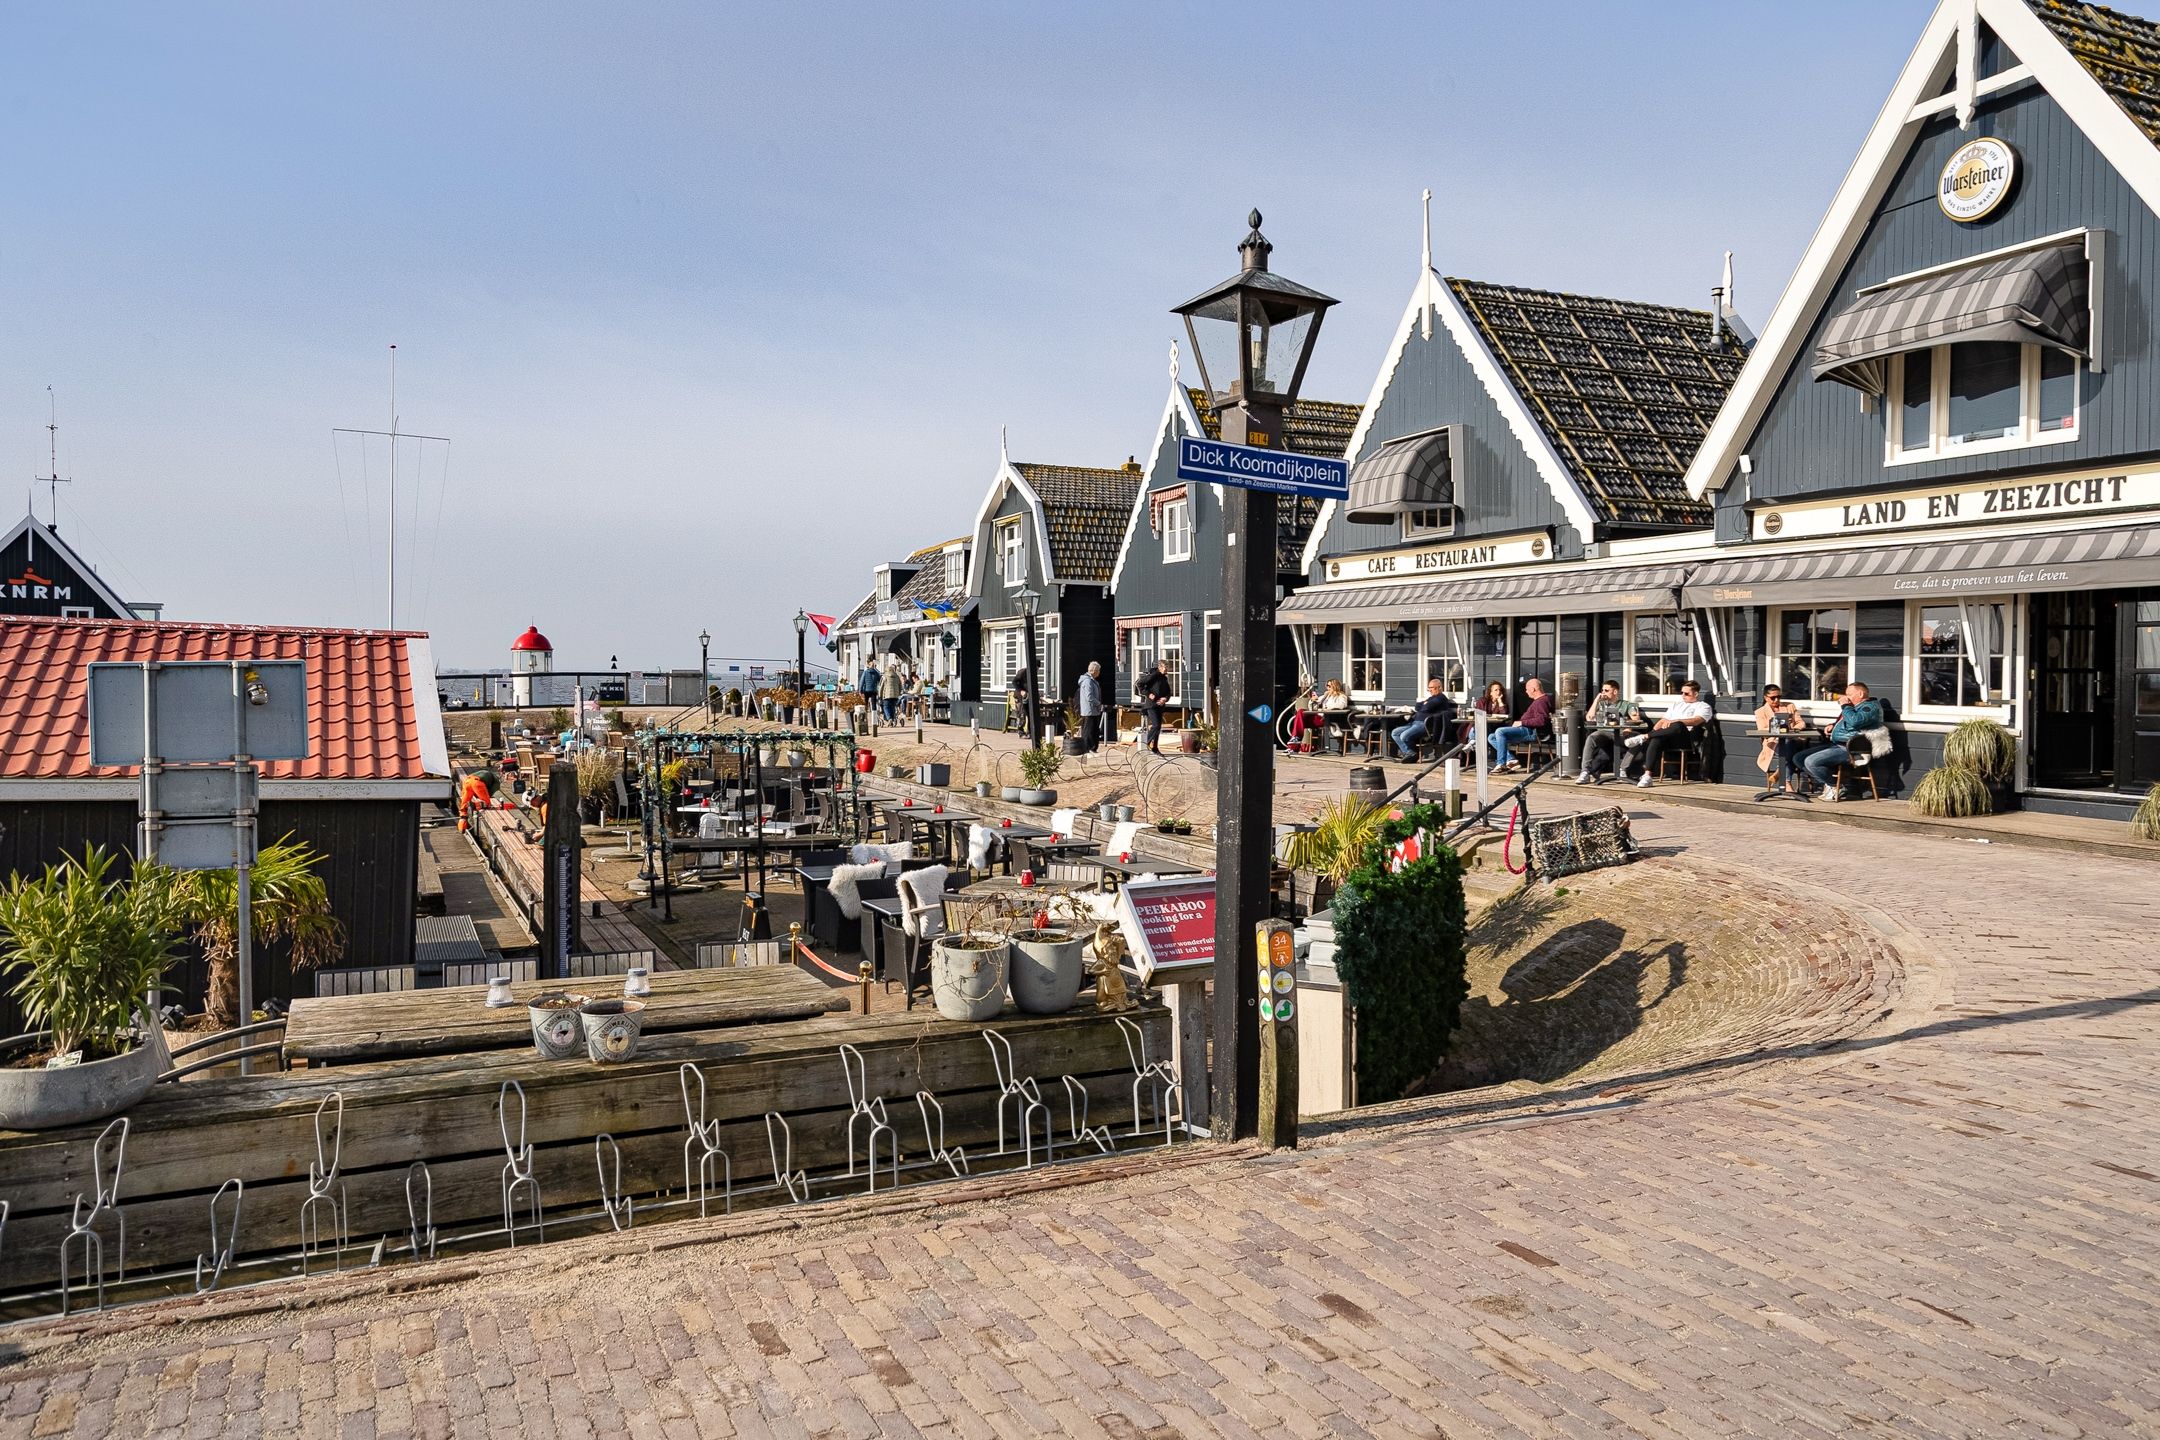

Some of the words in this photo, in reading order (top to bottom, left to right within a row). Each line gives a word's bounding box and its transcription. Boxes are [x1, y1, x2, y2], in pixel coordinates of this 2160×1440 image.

[1943, 165, 2005, 195] Warsteiner
[1956, 204, 1977, 212] EINZIG
[1977, 187, 1997, 206] WAHRE
[1250, 432, 1268, 444] 314
[1189, 444, 1225, 467] Dick
[1230, 451, 1341, 482] Koorndijkplein
[1227, 475, 1245, 484] Land-
[1252, 479, 1276, 489] Zeezicht
[1276, 483, 1298, 491] Marken
[1842, 500, 1906, 527] LAND
[1927, 493, 1960, 519] EN
[1983, 475, 2128, 514] ZEEZICHT
[1368, 556, 1396, 574] CAFE
[1415, 545, 1497, 569] RESTAURANT
[1894, 579, 1919, 590] Lezz,
[1922, 575, 1939, 588] dat
[1941, 575, 1950, 587] is
[1951, 576, 1991, 590] proeven
[1994, 574, 2014, 584] van
[2016, 570, 2034, 583] het
[2036, 568, 2069, 582] leven.
[1723, 587, 1753, 601] Warsteiner
[1135, 900, 1207, 915] PEEKABOO
[1140, 913, 1179, 925] looking
[1179, 912, 1195, 921] for
[1195, 911, 1203, 919] a
[1144, 924, 1177, 935] menu?
[1273, 934, 1288, 947] 34
[1169, 947, 1183, 956] will
[1185, 945, 1199, 954] tell
[1200, 944, 1214, 953] you
